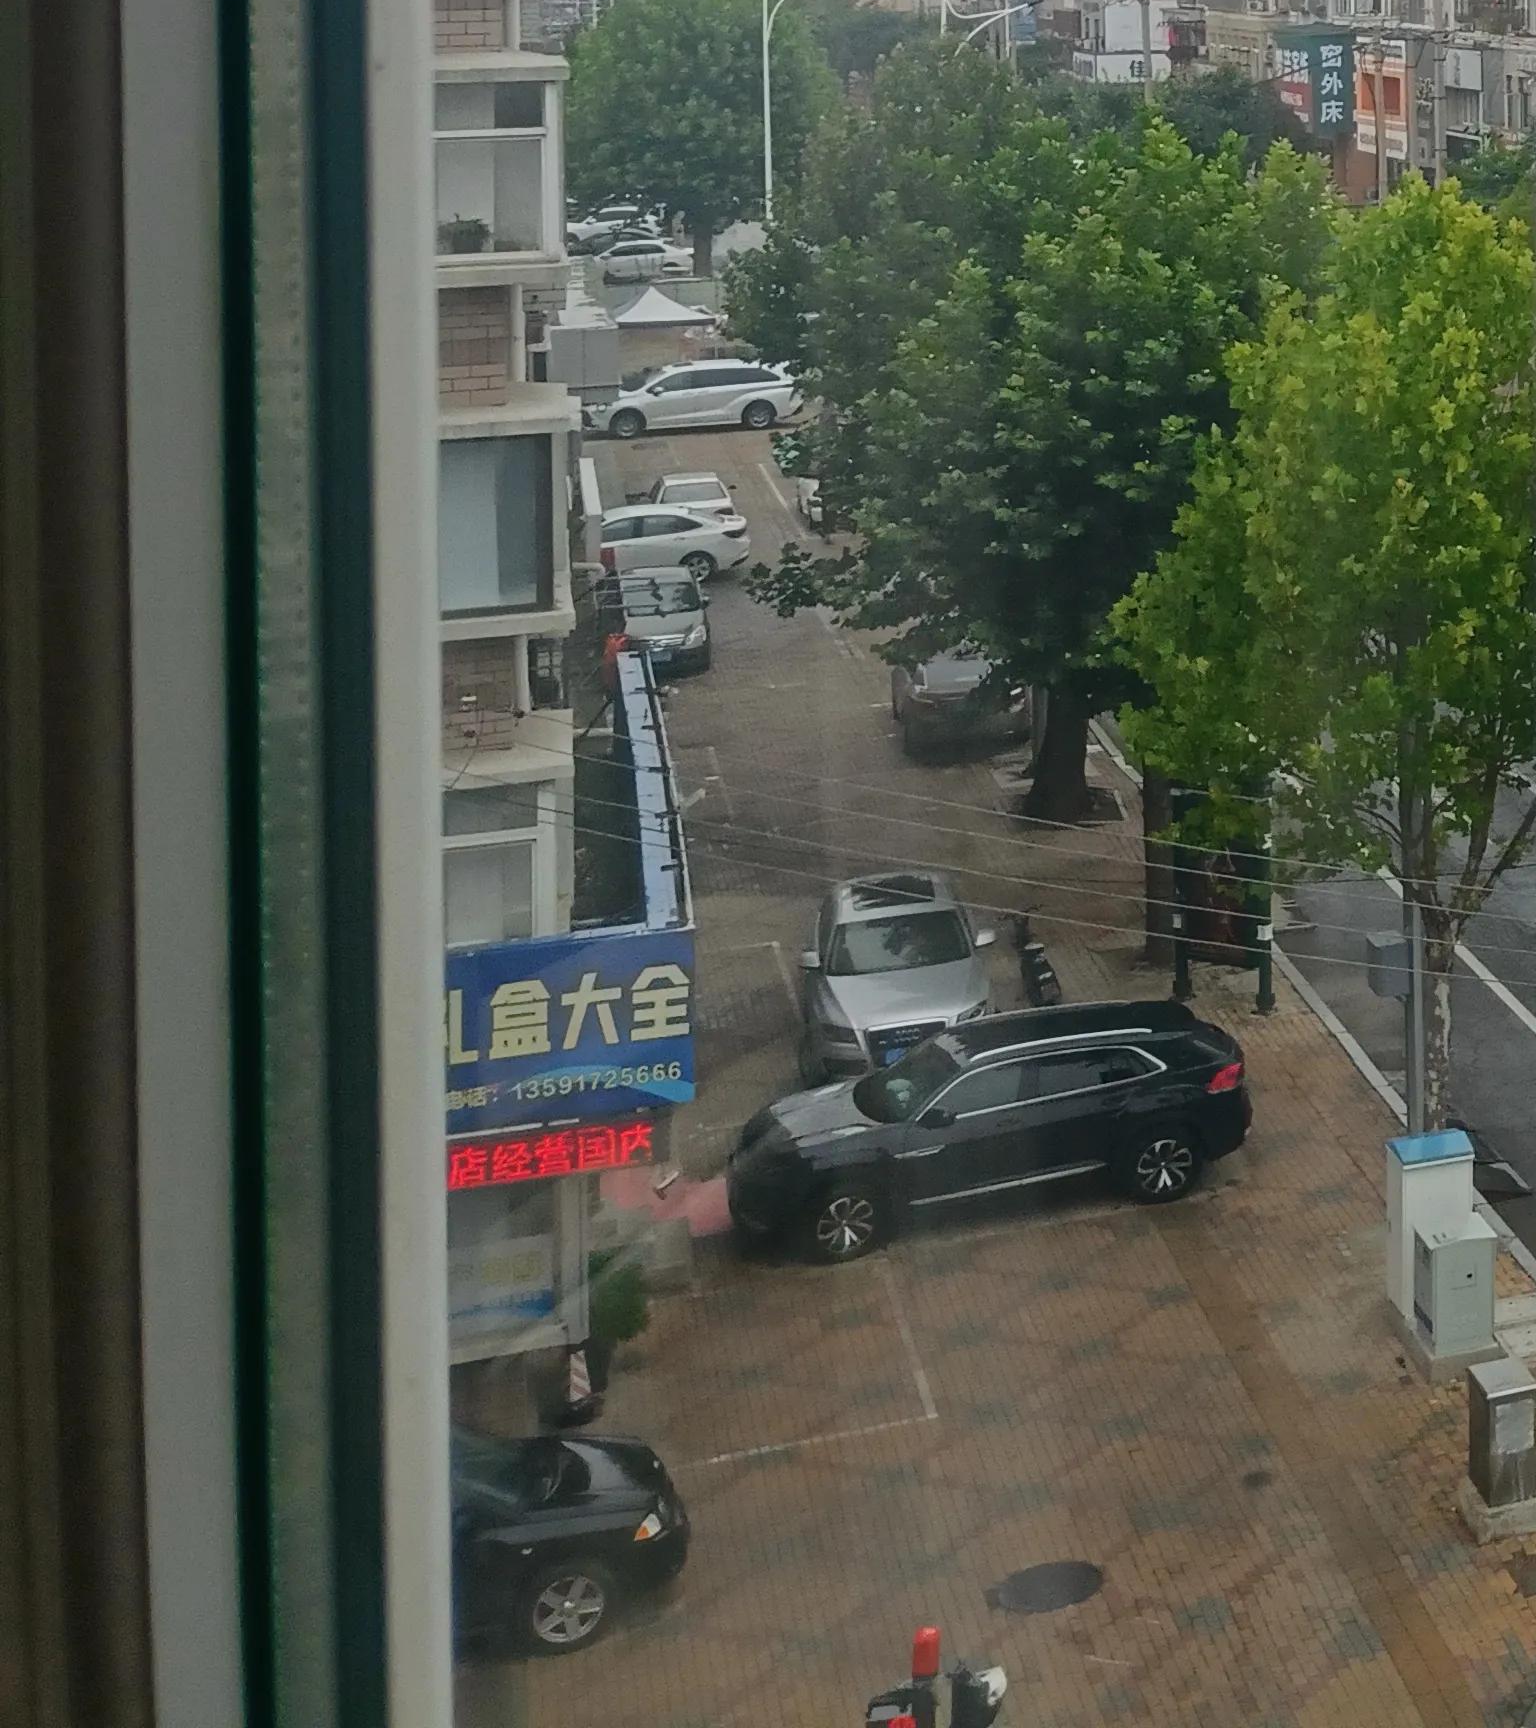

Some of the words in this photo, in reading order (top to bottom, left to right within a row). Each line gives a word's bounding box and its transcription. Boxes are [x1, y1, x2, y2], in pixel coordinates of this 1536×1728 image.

[449, 1124, 655, 1190] 店经营国内
